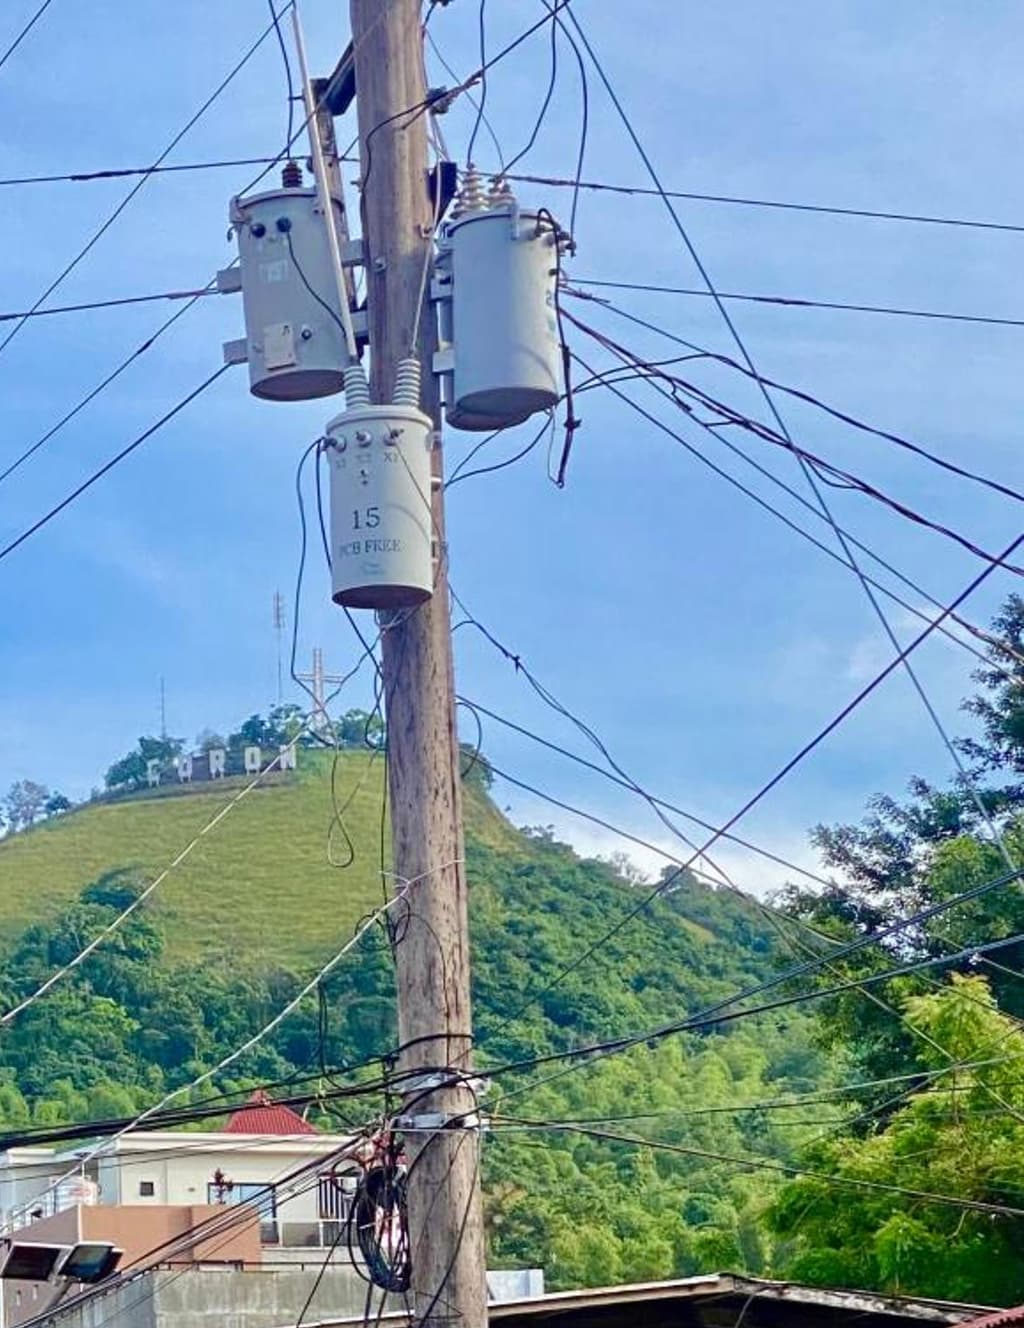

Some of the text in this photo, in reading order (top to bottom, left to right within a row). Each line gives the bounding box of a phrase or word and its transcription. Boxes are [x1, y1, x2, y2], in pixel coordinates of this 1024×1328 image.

[352, 506, 381, 530] 15
[364, 538, 402, 554] FREE
[147, 744, 296, 783] CORON
